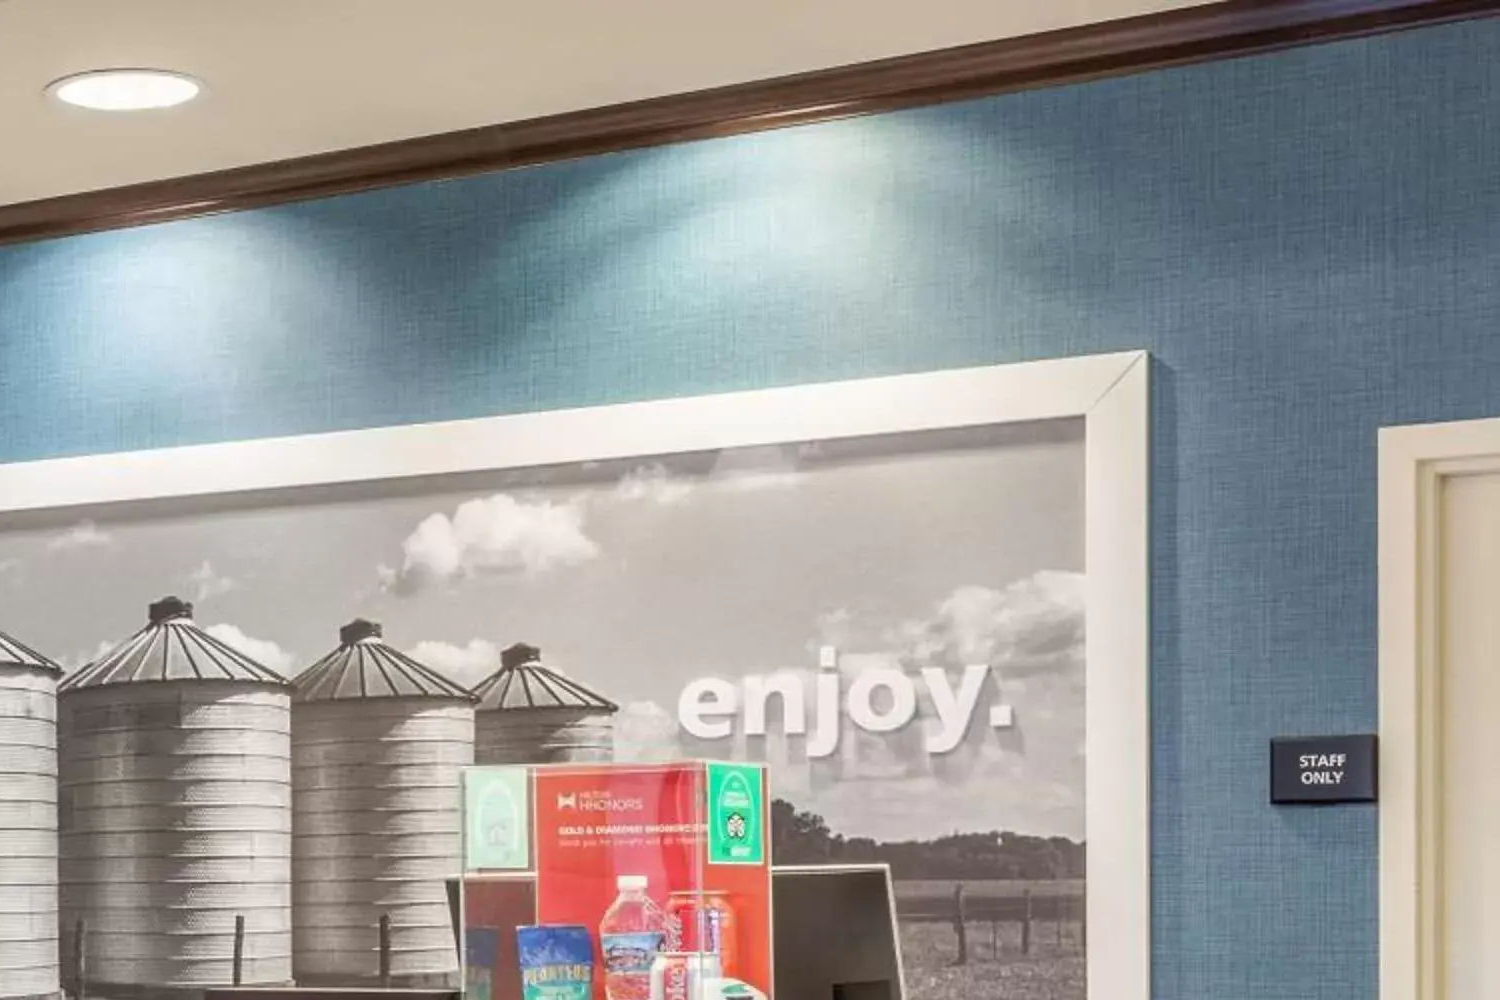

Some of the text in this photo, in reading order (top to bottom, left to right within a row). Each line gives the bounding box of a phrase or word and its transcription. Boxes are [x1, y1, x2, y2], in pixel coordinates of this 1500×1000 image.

[678, 645, 1013, 757] enjoy.
[1299, 753, 1347, 768] STAFF
[1301, 771, 1344, 785] ONLY
[579, 798, 644, 811] HHONORS
